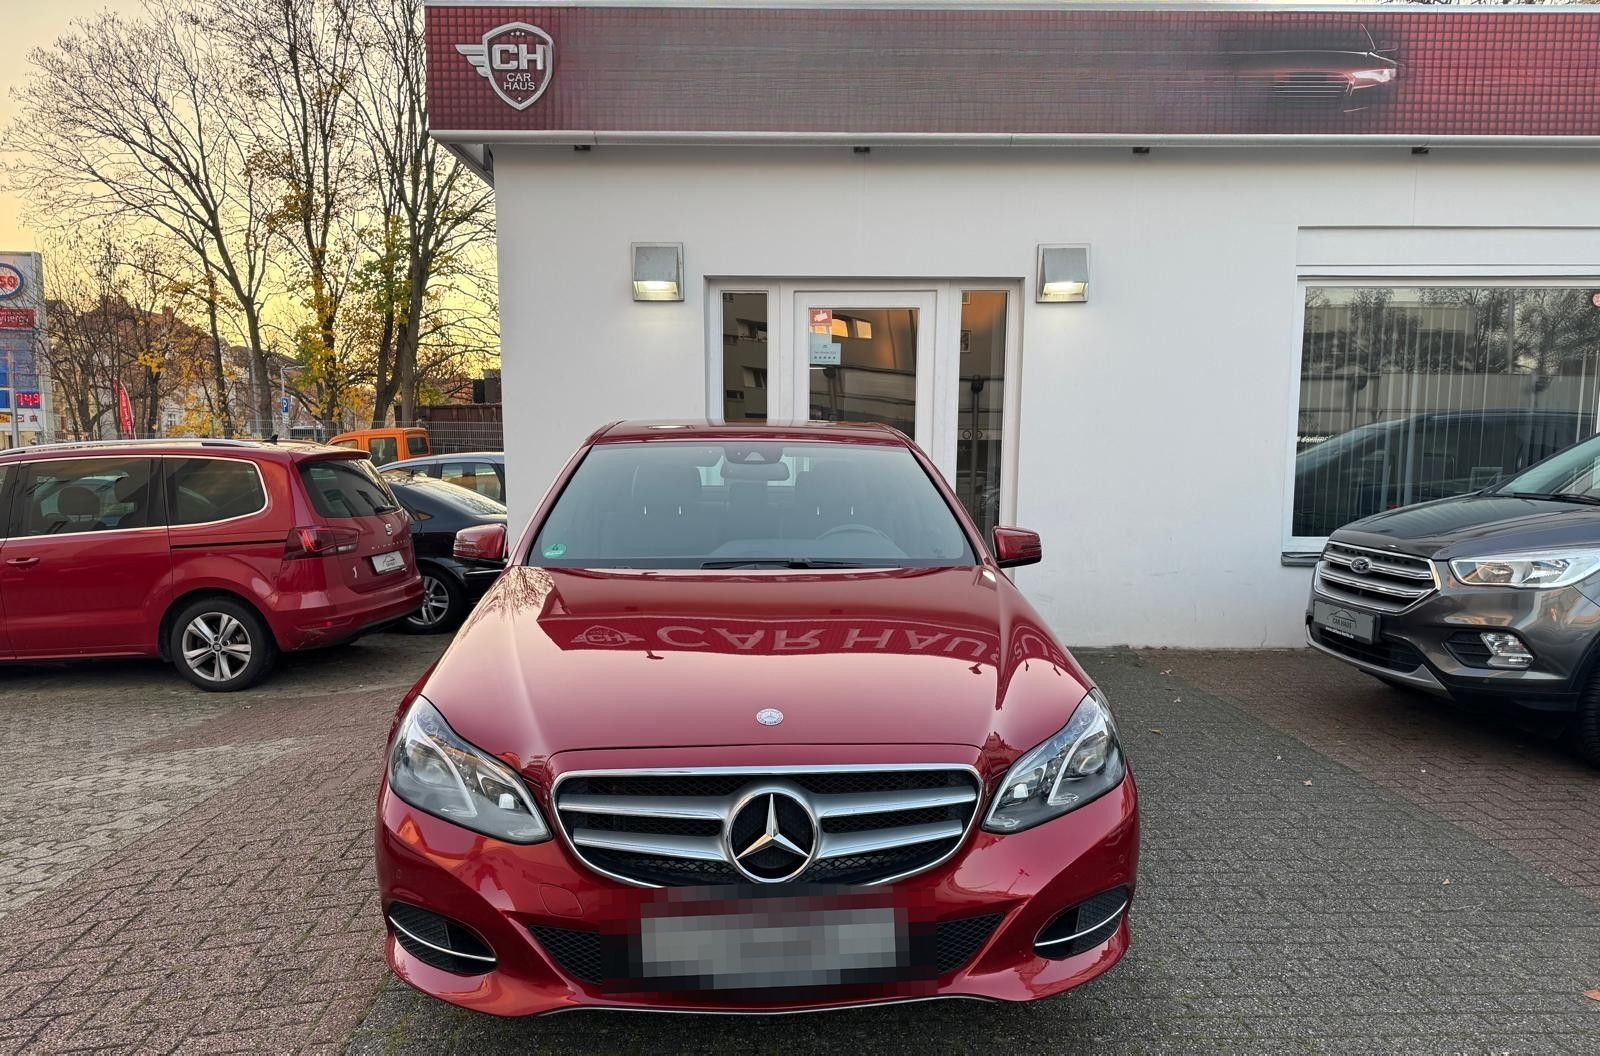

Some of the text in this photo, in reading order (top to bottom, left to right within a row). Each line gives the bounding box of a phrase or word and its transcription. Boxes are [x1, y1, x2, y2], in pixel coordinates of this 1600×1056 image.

[491, 43, 544, 70] CH
[506, 72, 531, 82] CAR
[503, 82, 535, 91] HAUS
